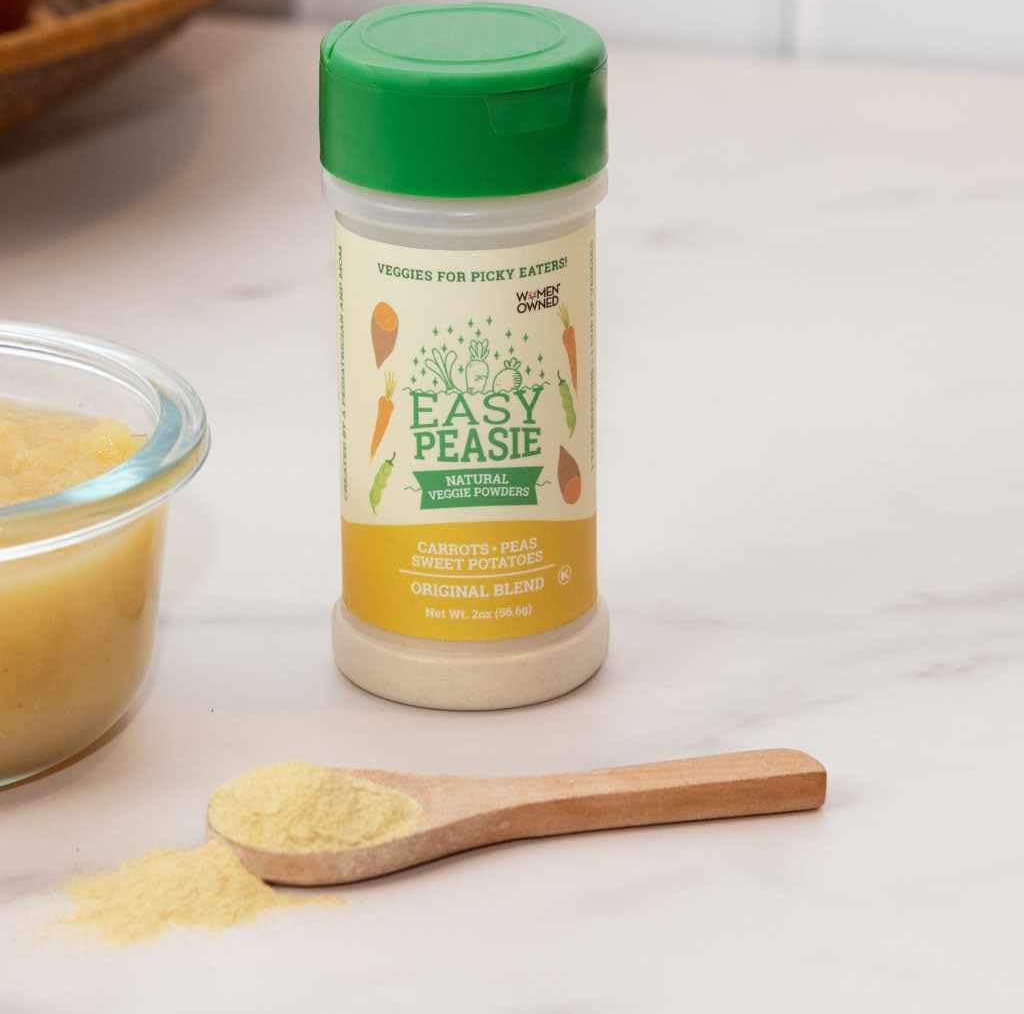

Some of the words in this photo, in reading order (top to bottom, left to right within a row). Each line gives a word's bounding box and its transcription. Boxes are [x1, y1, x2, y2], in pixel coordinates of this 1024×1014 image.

[377, 262, 433, 281] VEGGIES
[437, 271, 466, 283] FOR
[471, 268, 515, 283] PICKY
[519, 256, 568, 279] EATERS!
[517, 295, 559, 314] OWNED
[410, 386, 544, 429] EASY
[414, 427, 542, 463] PEASIE
[446, 473, 509, 486] NATURAL
[428, 488, 471, 500] VEGGIE
[474, 486, 530, 498] POWDERS
[417, 541, 489, 556] CARROTS
[500, 537, 537, 554] PEAS
[411, 553, 464, 571] SWEET
[468, 550, 544, 571] POTATOES
[410, 580, 489, 598] ORIGINAL
[493, 577, 544, 597] BLEND
[425, 607, 446, 619] Net
[471, 609, 493, 619] 2oz
